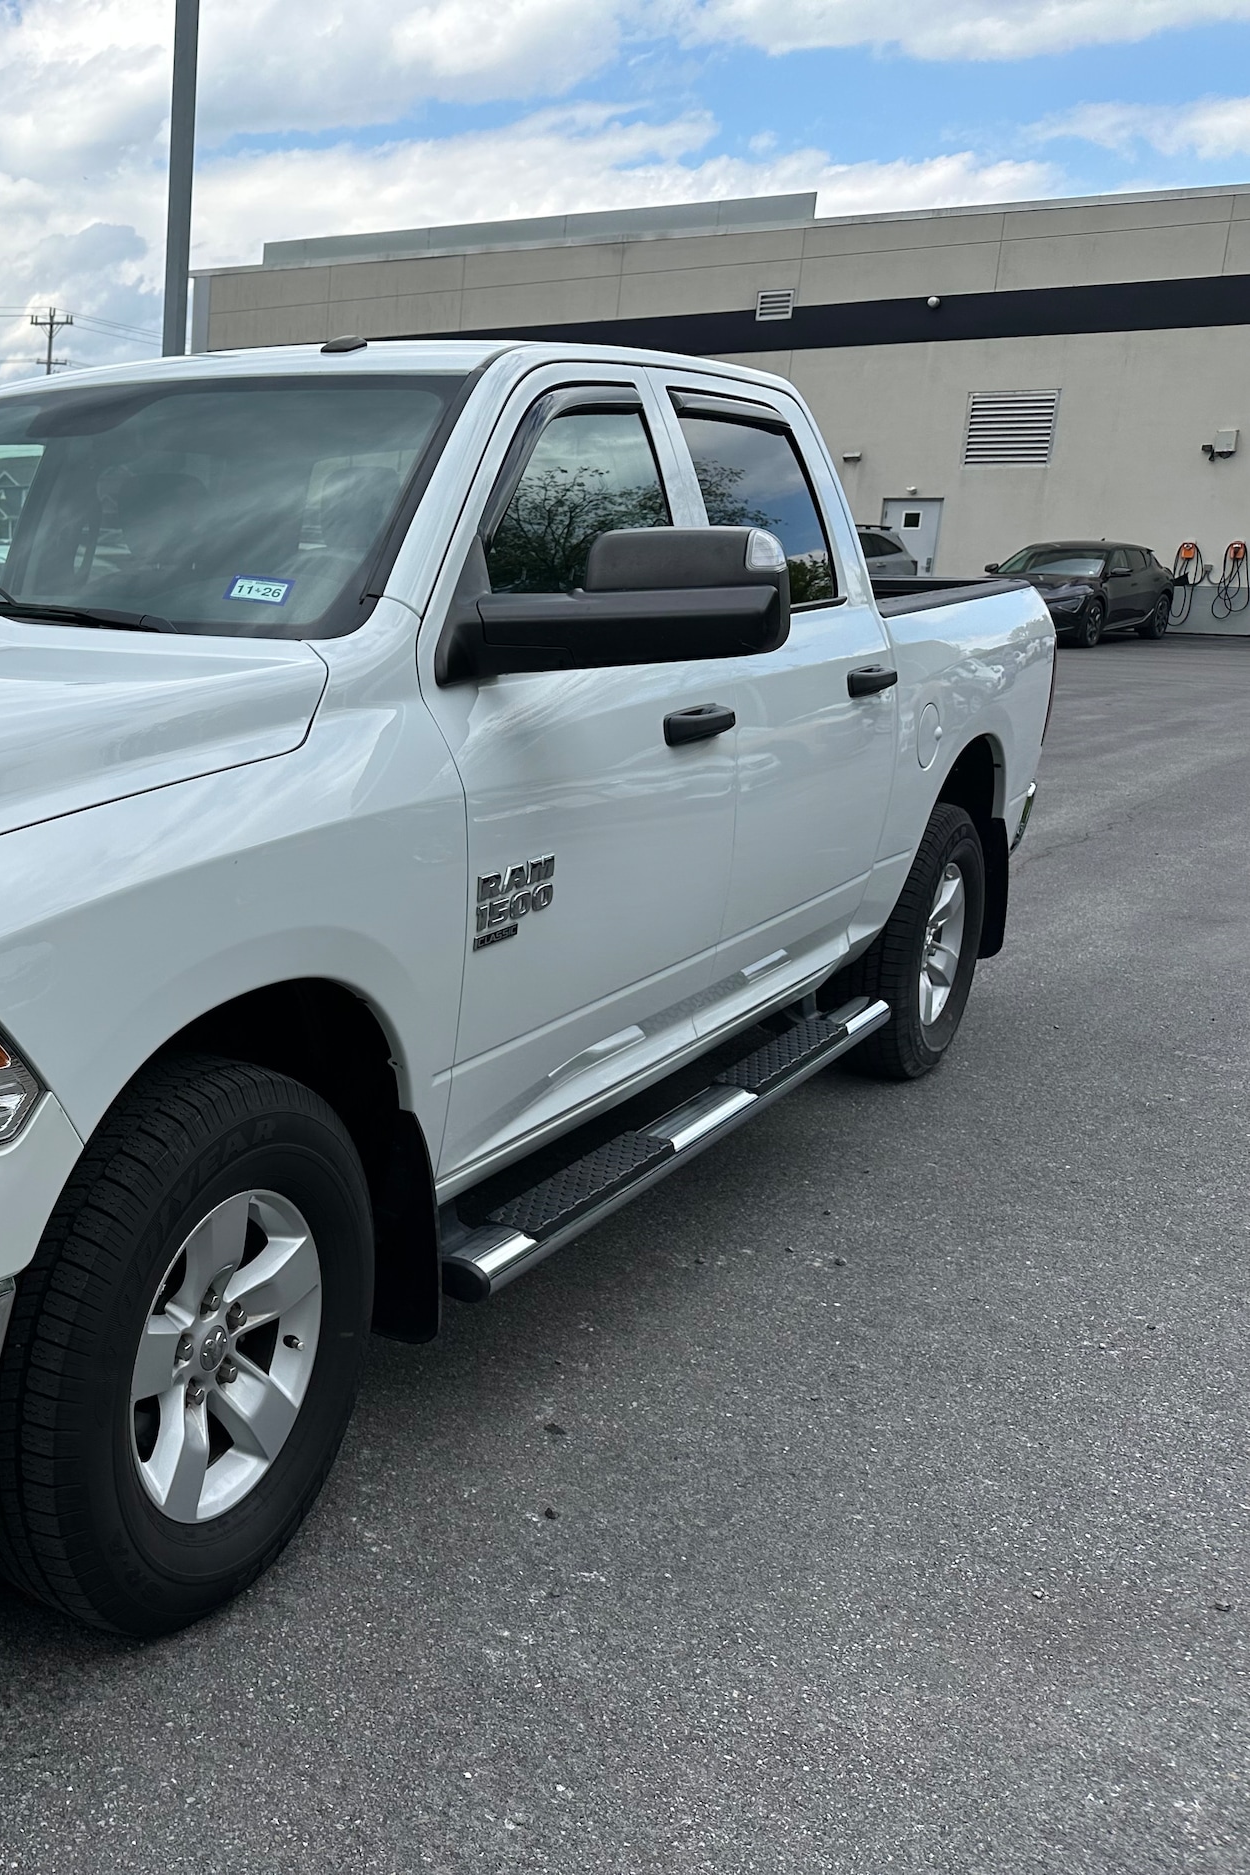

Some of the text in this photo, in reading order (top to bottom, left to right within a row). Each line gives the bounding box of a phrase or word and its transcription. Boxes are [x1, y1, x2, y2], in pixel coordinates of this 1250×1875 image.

[477, 853, 555, 903] RAM
[476, 882, 554, 933] 1500
[477, 925, 518, 947] CLASSIC
